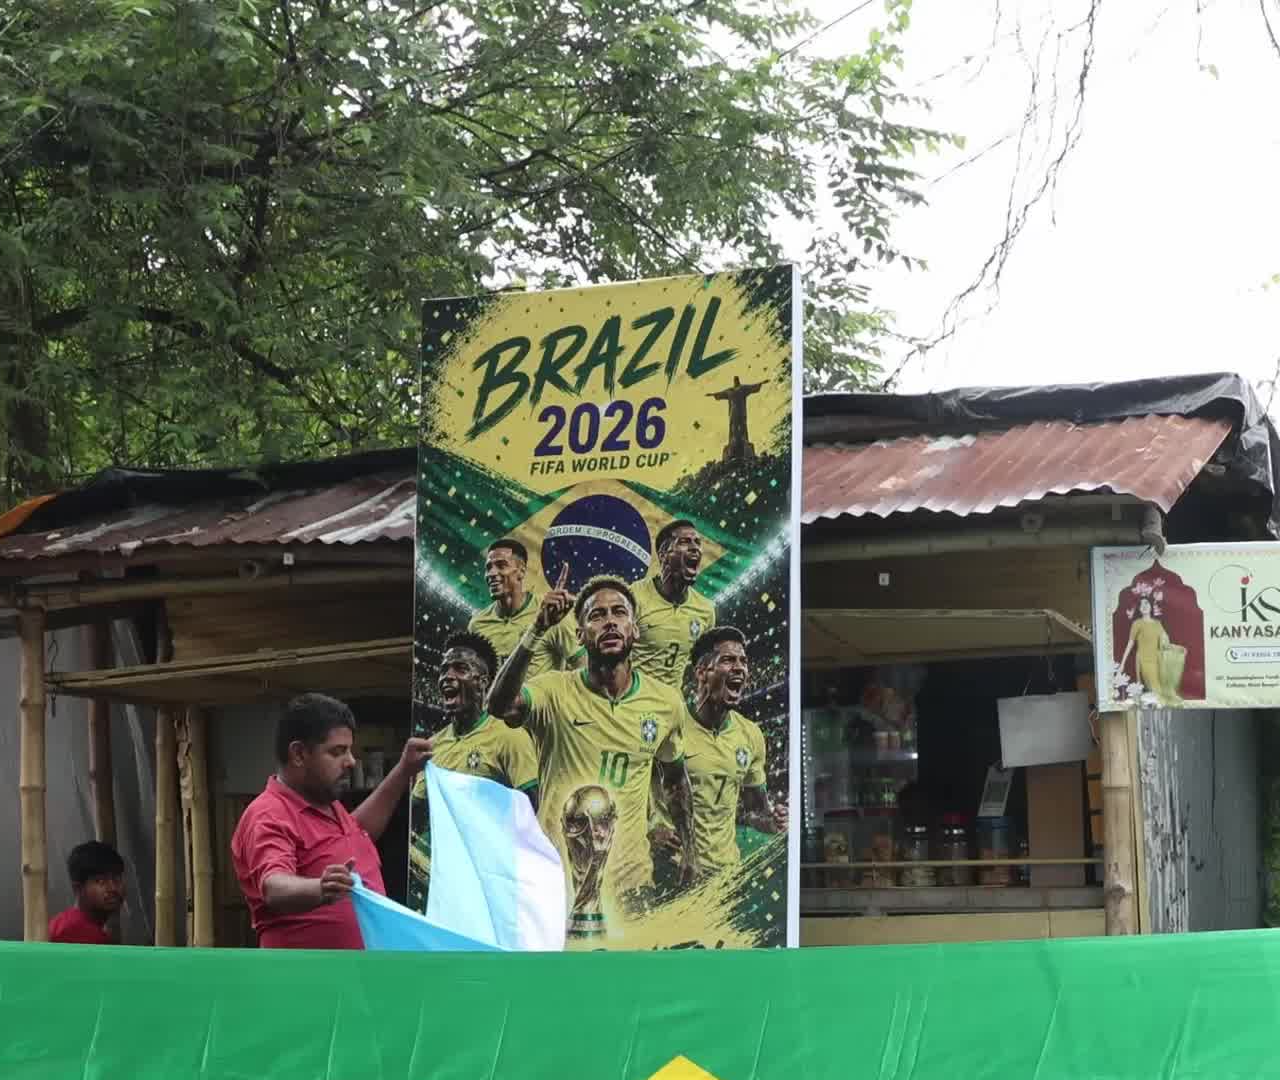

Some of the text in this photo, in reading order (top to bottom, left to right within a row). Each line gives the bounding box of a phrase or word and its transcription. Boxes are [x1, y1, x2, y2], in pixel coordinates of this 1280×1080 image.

[464, 297, 738, 444] BRAZIL
[534, 397, 667, 457] 2026
[530, 452, 670, 476] FIFA WORLD CUP
[550, 526, 582, 536] ORDEM
[597, 530, 648, 561] PROGRESSO
[599, 751, 630, 788] 10
